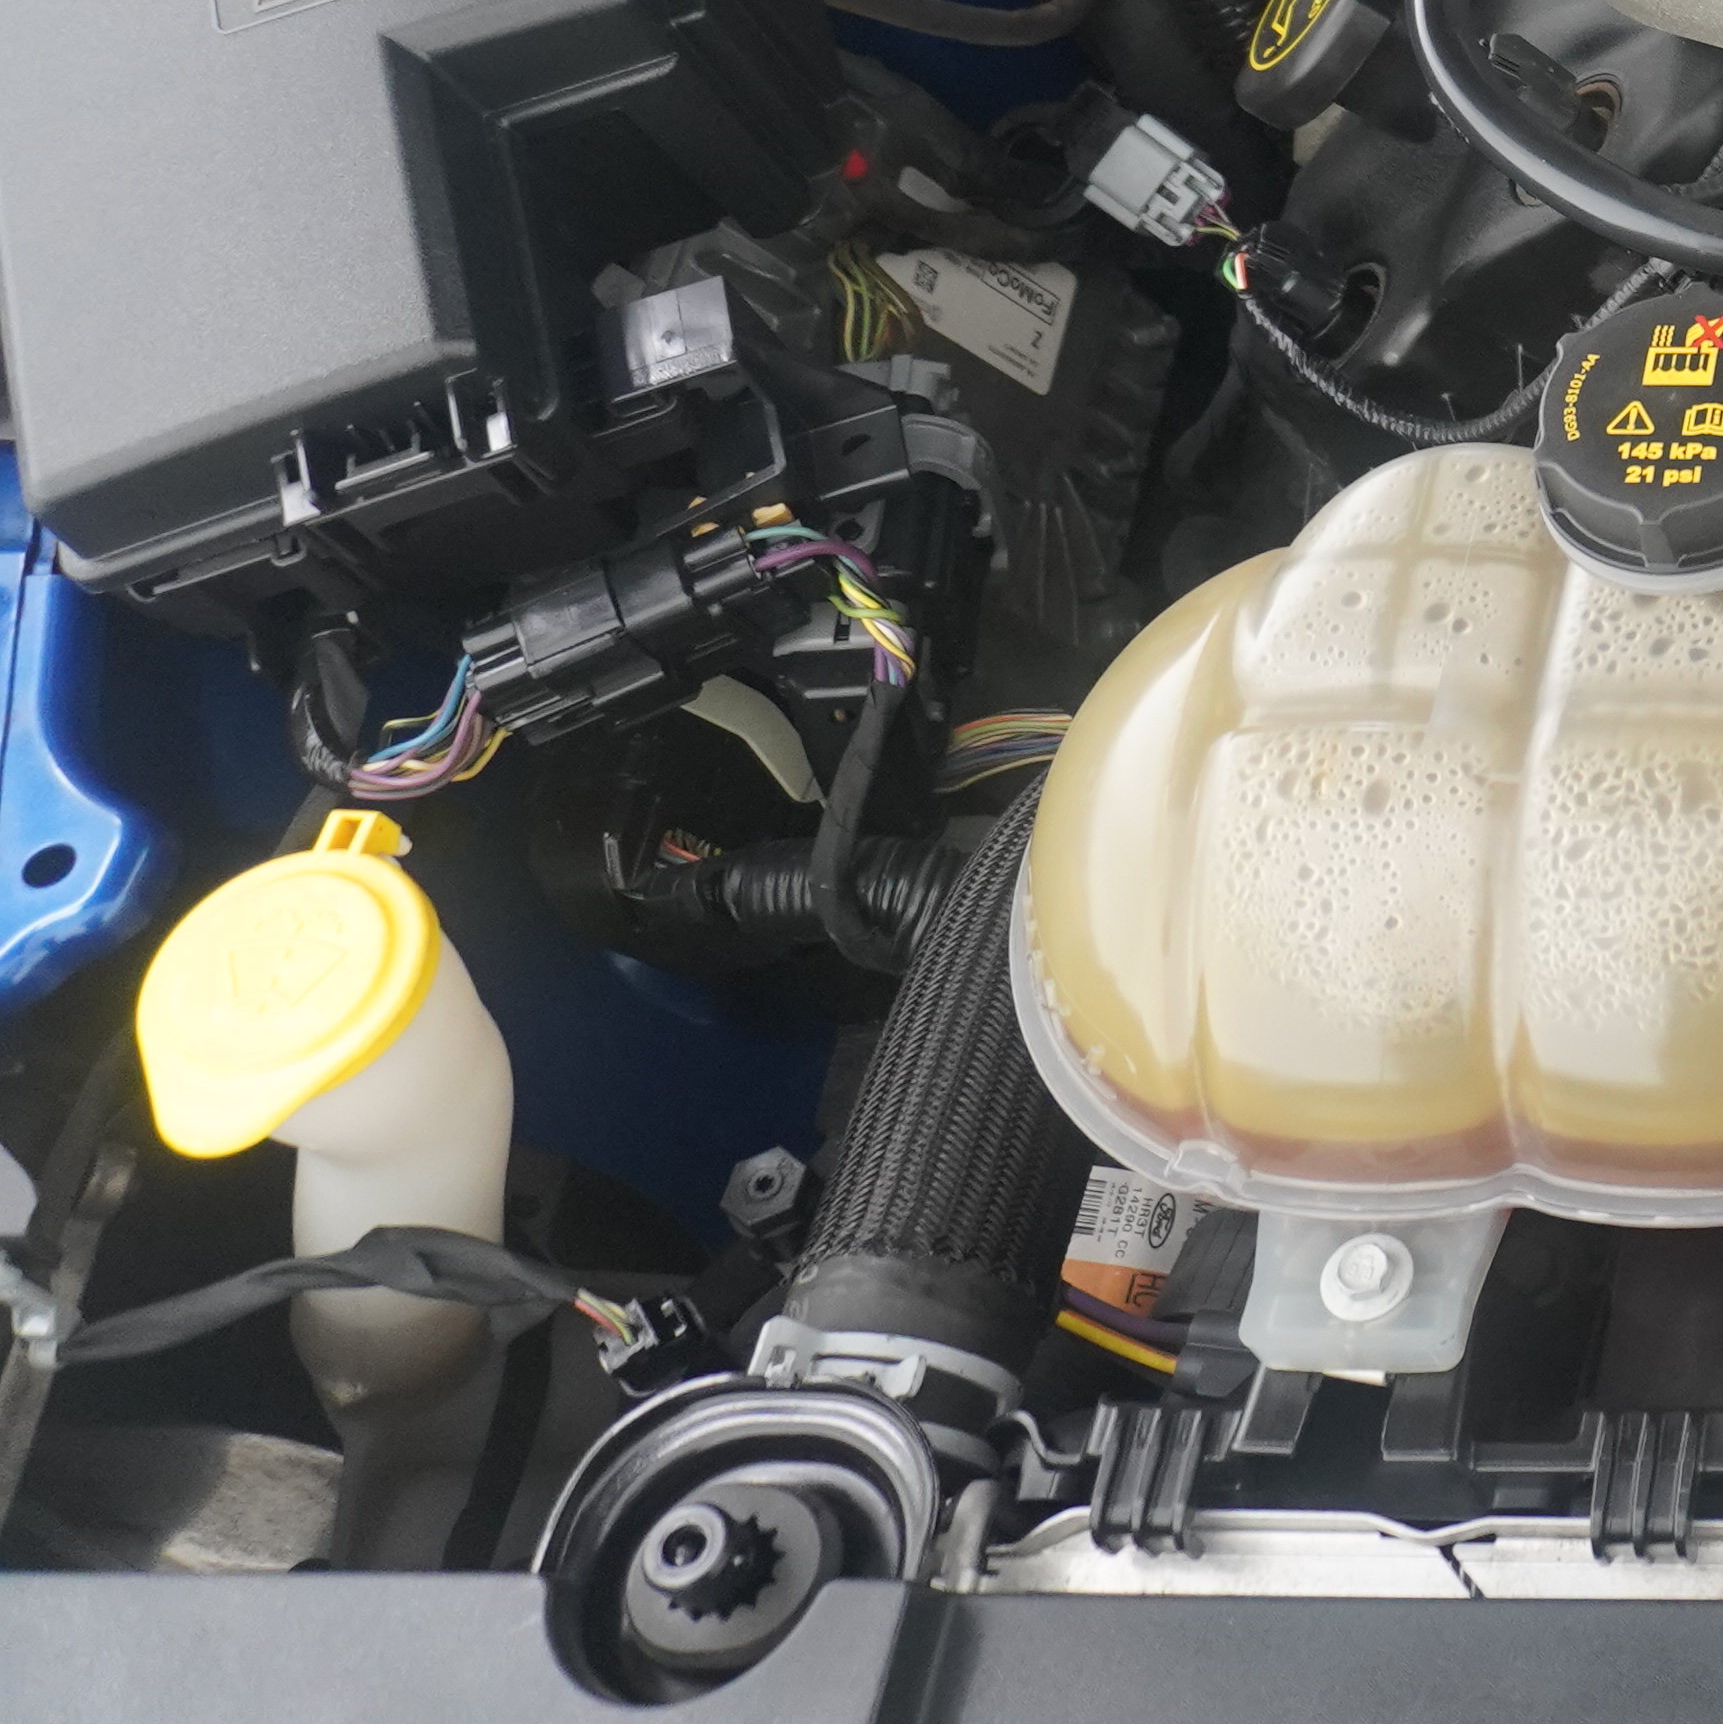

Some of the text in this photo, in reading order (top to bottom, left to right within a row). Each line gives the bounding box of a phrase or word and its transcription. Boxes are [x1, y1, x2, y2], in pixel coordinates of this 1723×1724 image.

[1617, 441, 1719, 461] 145 kPa
[1624, 465, 1703, 488] 21 psi
